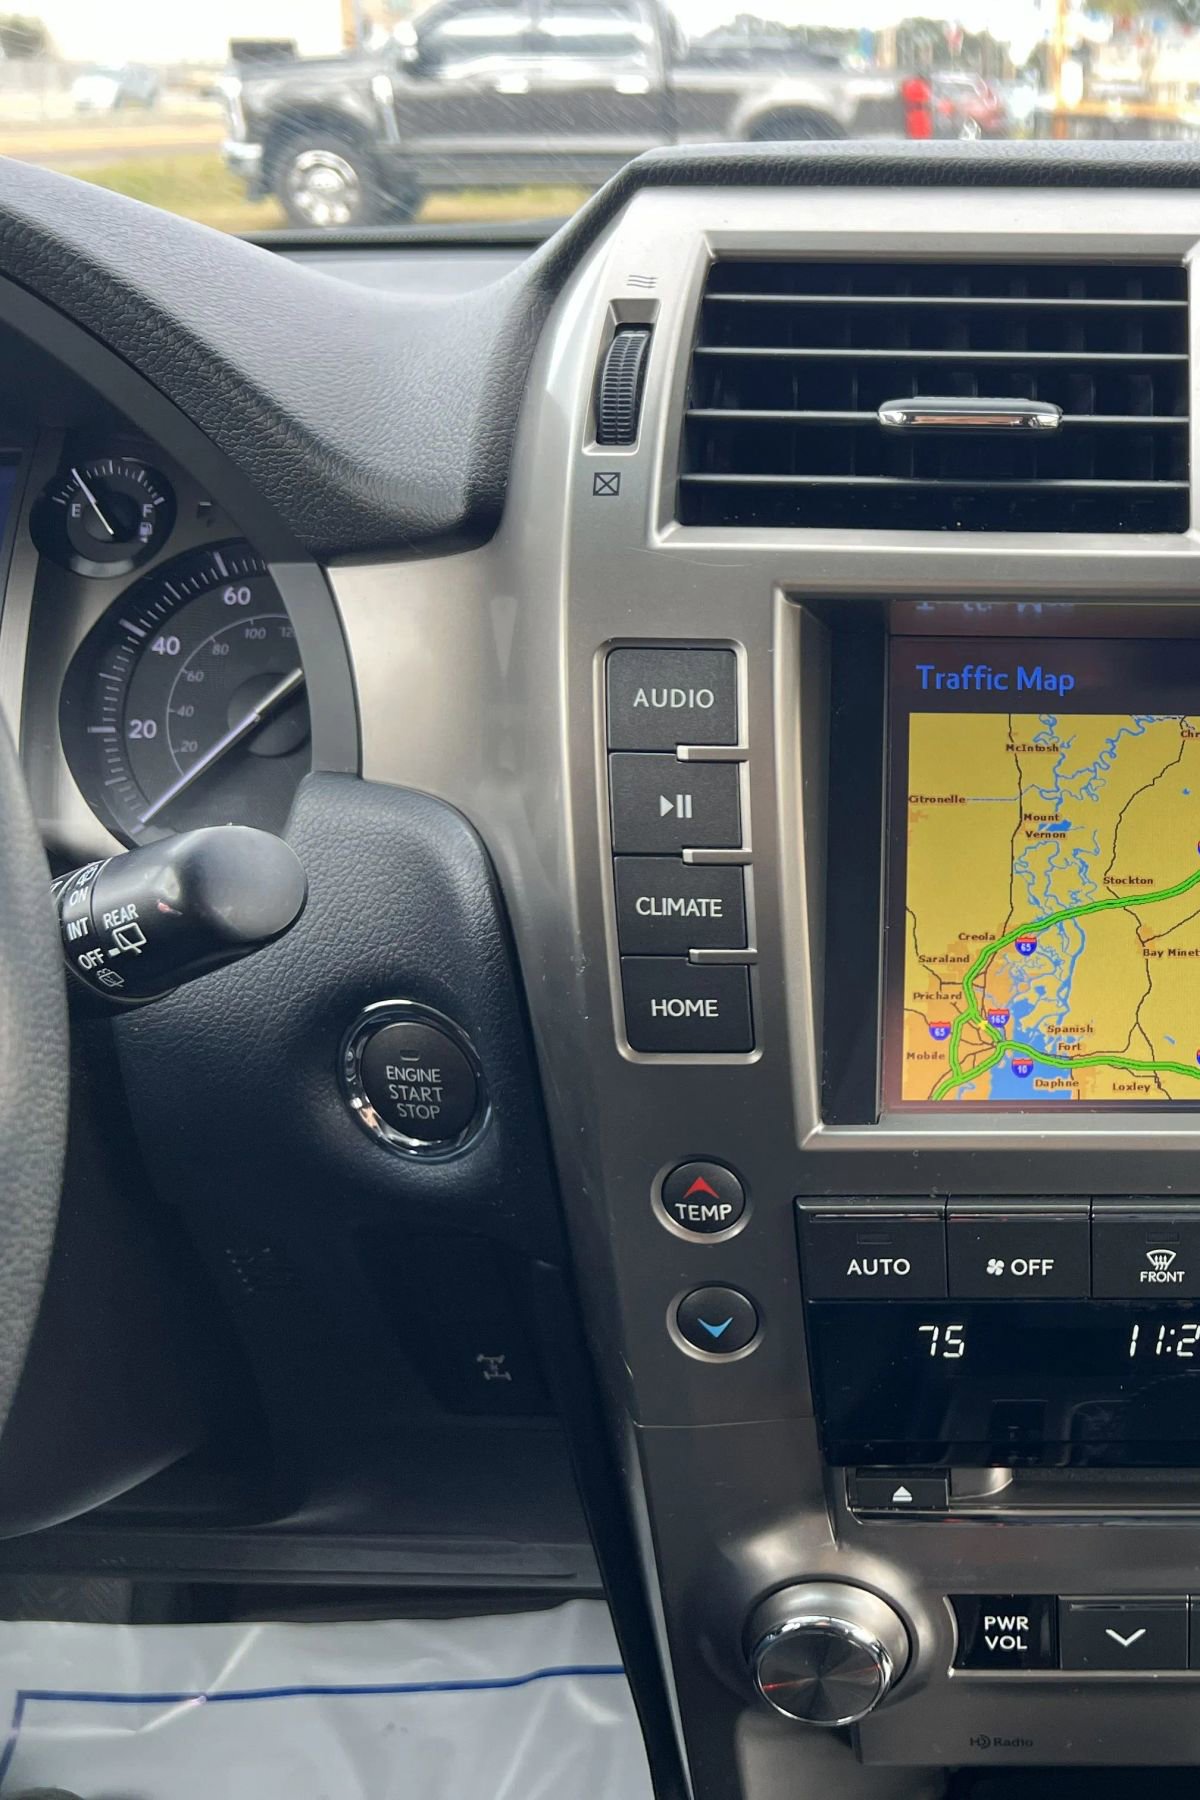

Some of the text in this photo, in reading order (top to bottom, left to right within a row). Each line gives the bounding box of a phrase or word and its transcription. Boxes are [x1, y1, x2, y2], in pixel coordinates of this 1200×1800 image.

[71, 503, 81, 517] E
[143, 503, 154, 517] F
[223, 586, 251, 605] 60
[244, 627, 266, 639] 100
[280, 626, 296, 637] 12
[152, 636, 180, 655] 40
[212, 643, 229, 655] 80
[187, 671, 204, 682] 60
[915, 664, 1075, 696] Traffic Map
[633, 688, 715, 709] AUDIO
[177, 705, 194, 717] 40
[129, 719, 157, 738] 20
[181, 741, 198, 753] 20
[1006, 743, 1059, 754] McIntosh
[909, 794, 966, 805] Citronelle
[1023, 813, 1060, 823] Mount
[1025, 830, 1066, 840] Vernon
[1103, 875, 1154, 885] Stockton
[69, 886, 89, 906] ON
[635, 896, 724, 918] CLIMATE
[102, 903, 139, 930] REAR
[67, 917, 88, 941] INT
[958, 932, 996, 942] Creola
[1020, 942, 1032, 952] 65
[1143, 947, 1163, 959] Bay
[78, 947, 105, 970] OFF
[918, 954, 970, 964] Saraland
[913, 990, 962, 1001] Prichard
[650, 998, 719, 1018] HOME
[991, 1013, 1006, 1025] 165
[934, 1027, 946, 1037] 65
[1047, 1023, 1094, 1036] Spanish
[1058, 1042, 1082, 1052] Fort
[906, 1051, 946, 1061] Mobile
[386, 1065, 442, 1084] ENGINE
[1017, 1064, 1028, 1075] 10
[1035, 1078, 1079, 1090] Daphne
[1112, 1082, 1151, 1094] Loxley
[389, 1084, 444, 1103] START
[396, 1103, 441, 1120] STOP
[675, 1202, 733, 1221] TEMP
[847, 1258, 911, 1276] AUTO
[1010, 1259, 1055, 1276] OFF
[1139, 1271, 1185, 1284] FRONT
[918, 1324, 966, 1359] 75
[984, 1615, 1029, 1631] PWR
[985, 1635, 1028, 1650] VOL
[993, 1736, 1033, 1748] Radio
